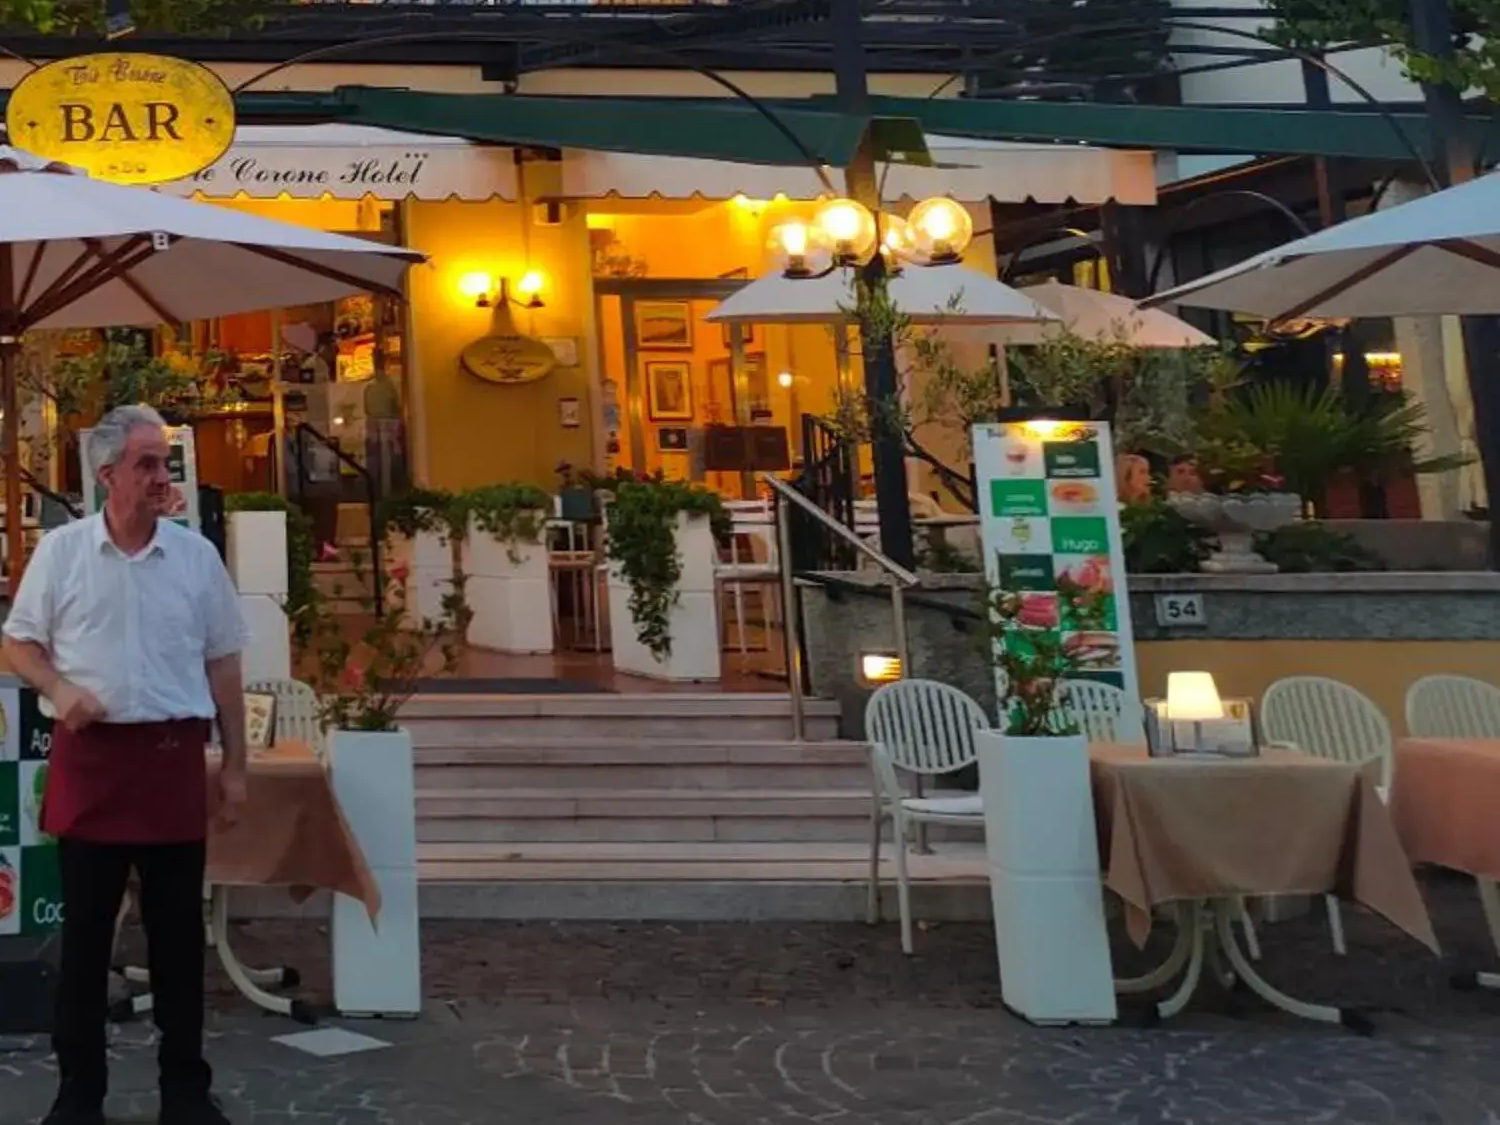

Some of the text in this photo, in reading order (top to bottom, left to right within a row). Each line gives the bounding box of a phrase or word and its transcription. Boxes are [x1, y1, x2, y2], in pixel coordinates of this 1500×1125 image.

[58, 101, 185, 143] BAR
[230, 156, 331, 184] Corone
[340, 157, 424, 185] Hotel
[1061, 537, 1100, 553] Hugo
[1168, 600, 1197, 618] 54
